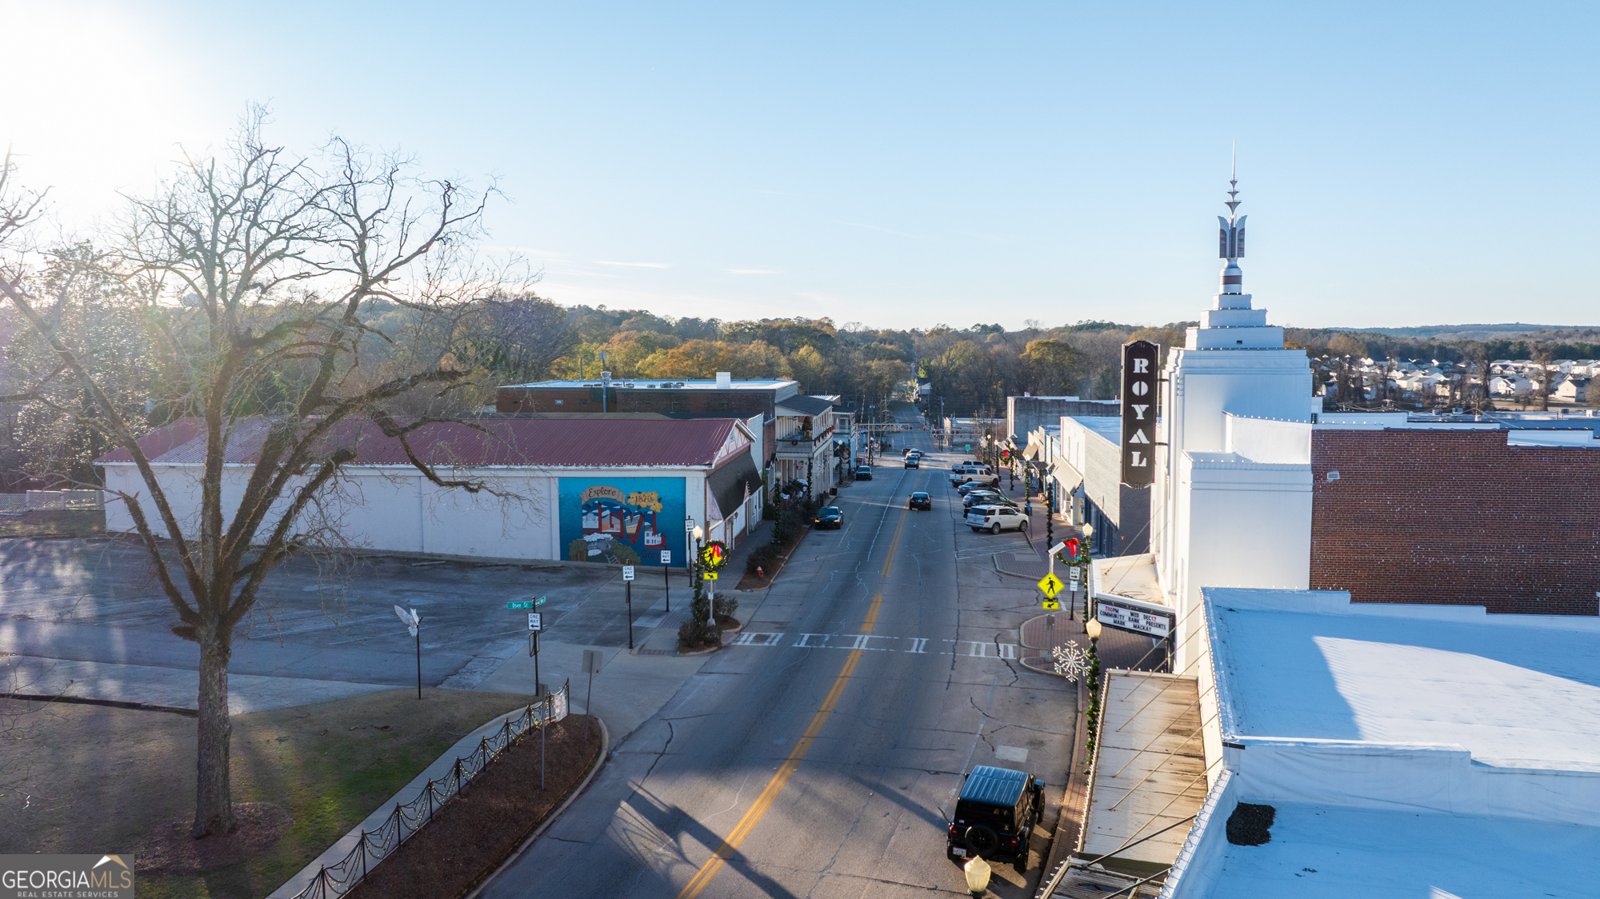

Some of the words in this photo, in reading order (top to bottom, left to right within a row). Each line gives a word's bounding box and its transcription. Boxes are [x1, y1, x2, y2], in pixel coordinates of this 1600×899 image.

[1129, 358, 1150, 467] ROYAL
[588, 487, 617, 498] Explore
[1100, 610, 1125, 620] COMMUNITY
[1145, 621, 1166, 630] PRESENTS
